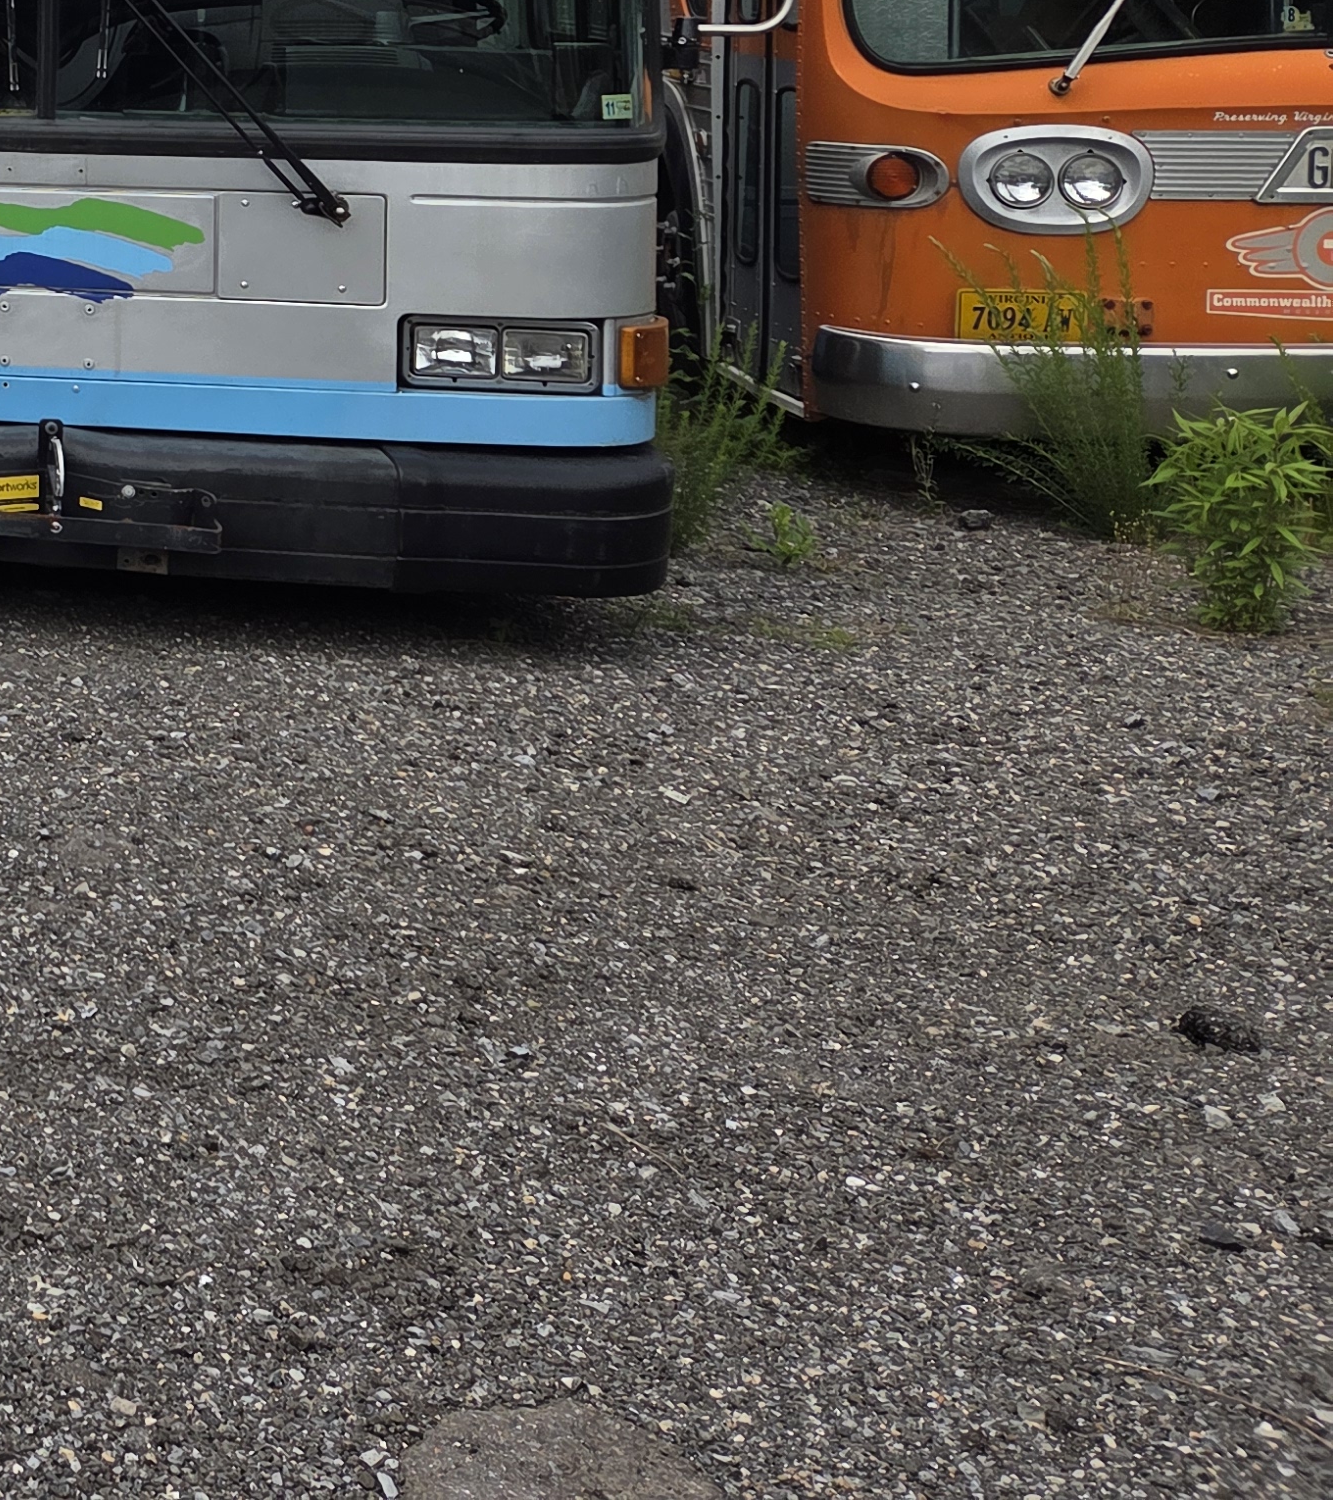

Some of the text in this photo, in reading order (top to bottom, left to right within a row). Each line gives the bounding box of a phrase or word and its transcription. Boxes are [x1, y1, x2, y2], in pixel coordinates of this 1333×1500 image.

[1213, 111, 1288, 125] Preserving
[1308, 146, 1333, 189] G
[988, 294, 1051, 305] VIRGINI
[1213, 293, 1332, 308] Commonwealth
